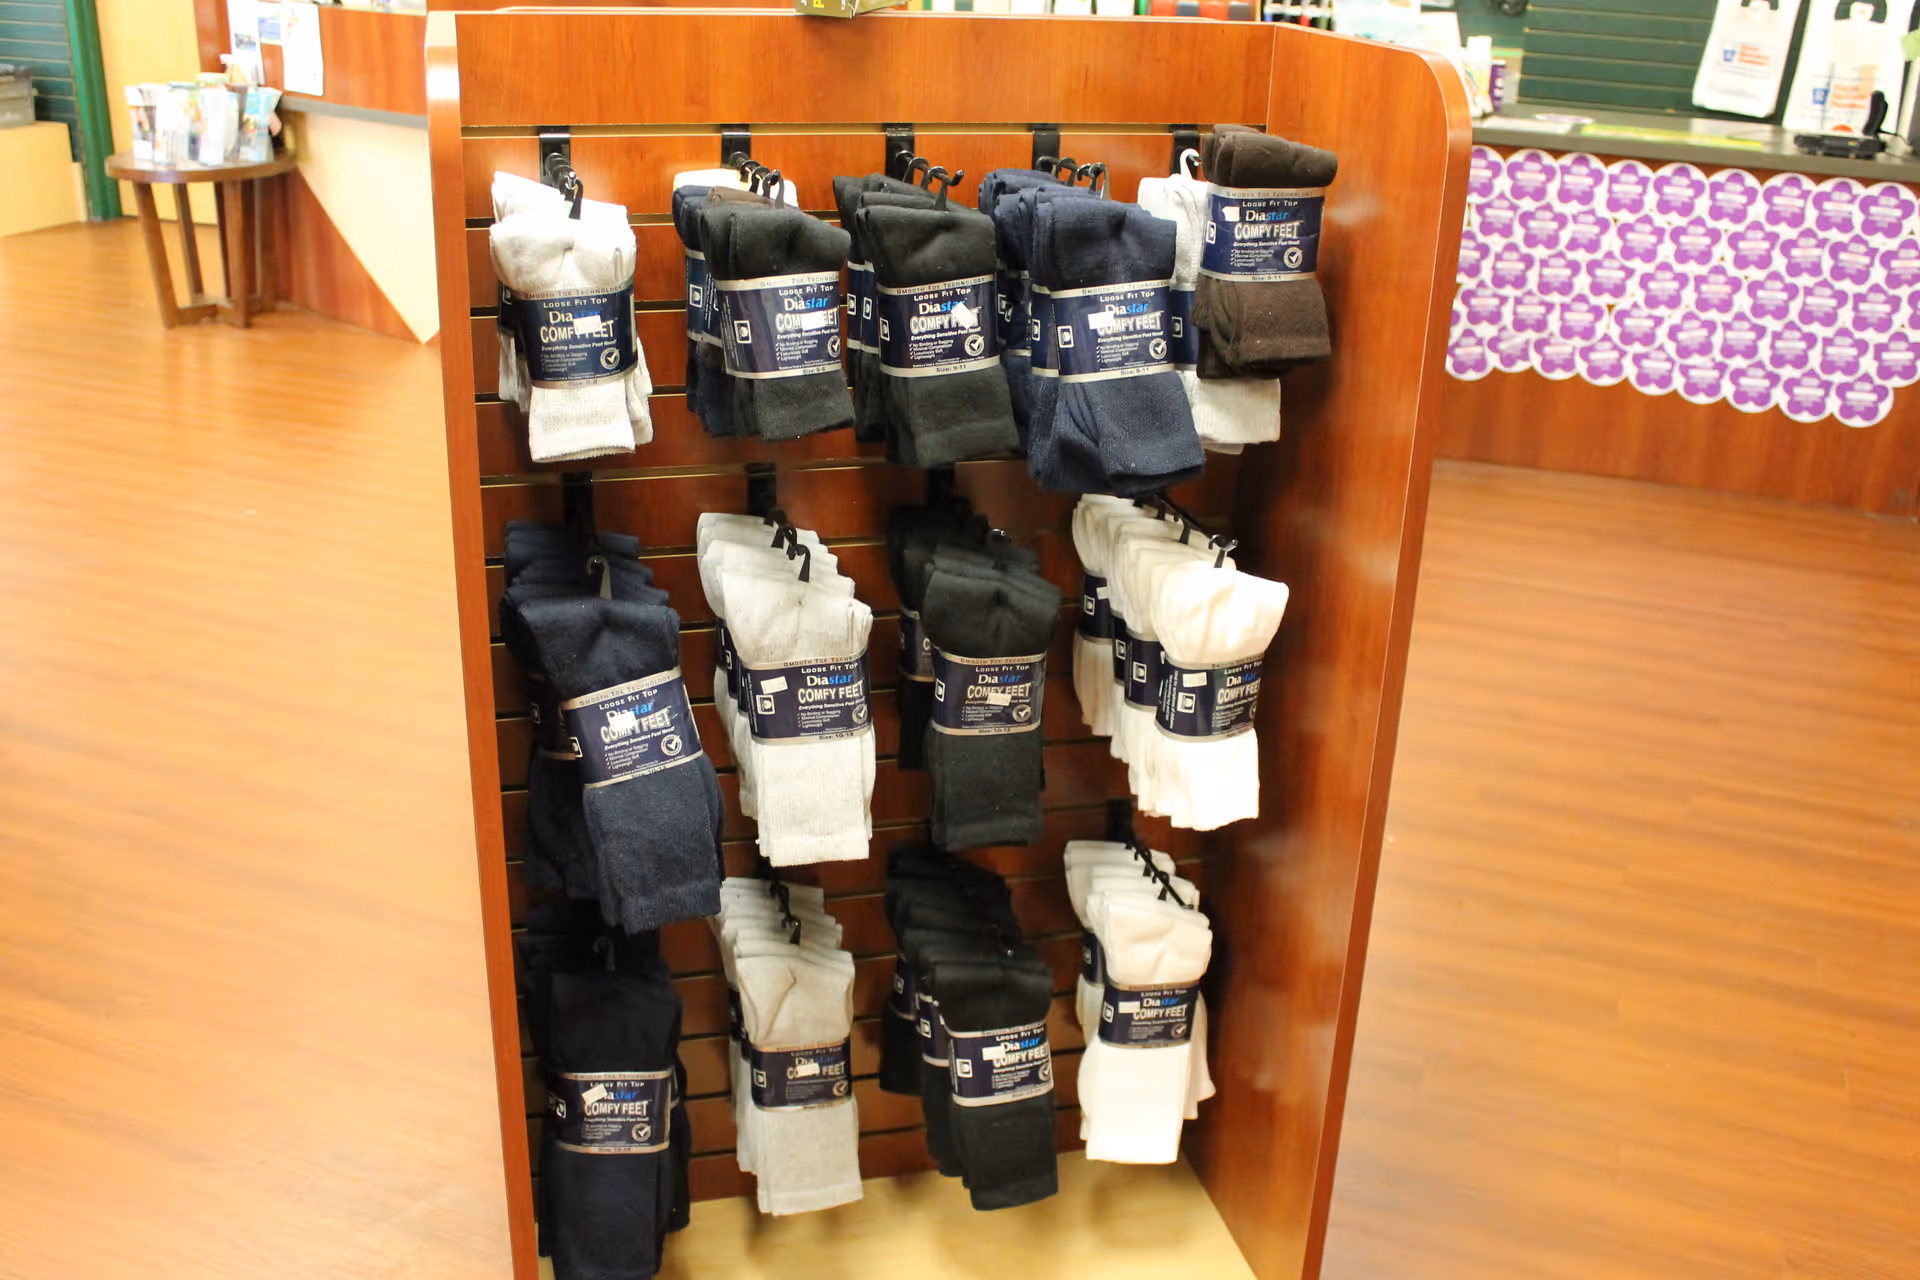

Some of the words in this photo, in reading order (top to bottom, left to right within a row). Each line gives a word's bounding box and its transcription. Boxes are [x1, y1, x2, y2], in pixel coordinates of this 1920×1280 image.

[1245, 210, 1288, 221] Diastar
[1234, 222, 1272, 240] COMFY
[1273, 221, 1299, 238] FEET
[944, 277, 984, 288] TECHNOLOGY
[779, 288, 804, 296] LOOSE
[914, 293, 938, 301] LOOSE
[1100, 294, 1124, 302] LOOSE
[543, 300, 572, 308] LOOSE
[784, 296, 829, 311] Diastar
[1105, 303, 1149, 315] Diastar
[910, 314, 950, 334] COMFY
[951, 308, 979, 328] FT
[1136, 312, 1161, 330] FEET
[831, 650, 864, 662] TECHN
[844, 662, 858, 670] TOP
[806, 674, 853, 687] Diastar
[978, 674, 1021, 684] Diastar
[798, 688, 836, 704] COMFY
[838, 680, 863, 699] FEET
[967, 685, 1004, 699] COMFY
[1006, 682, 1031, 697] FEET
[1217, 686, 1245, 705] COMFY
[599, 698, 625, 710] LOOSE
[628, 694, 640, 702] FIT
[642, 689, 658, 698] TOP
[606, 702, 654, 722] Dtar
[641, 707, 671, 731] FEET
[1133, 1008, 1164, 1020] COMFY
[1165, 1004, 1187, 1017] FEET
[1000, 1038, 1040, 1052] Diastar
[823, 1061, 845, 1075] FEET
[604, 1090, 637, 1100] astar
[584, 1103, 620, 1116] COMFY
[622, 1101, 648, 1116] FEET
